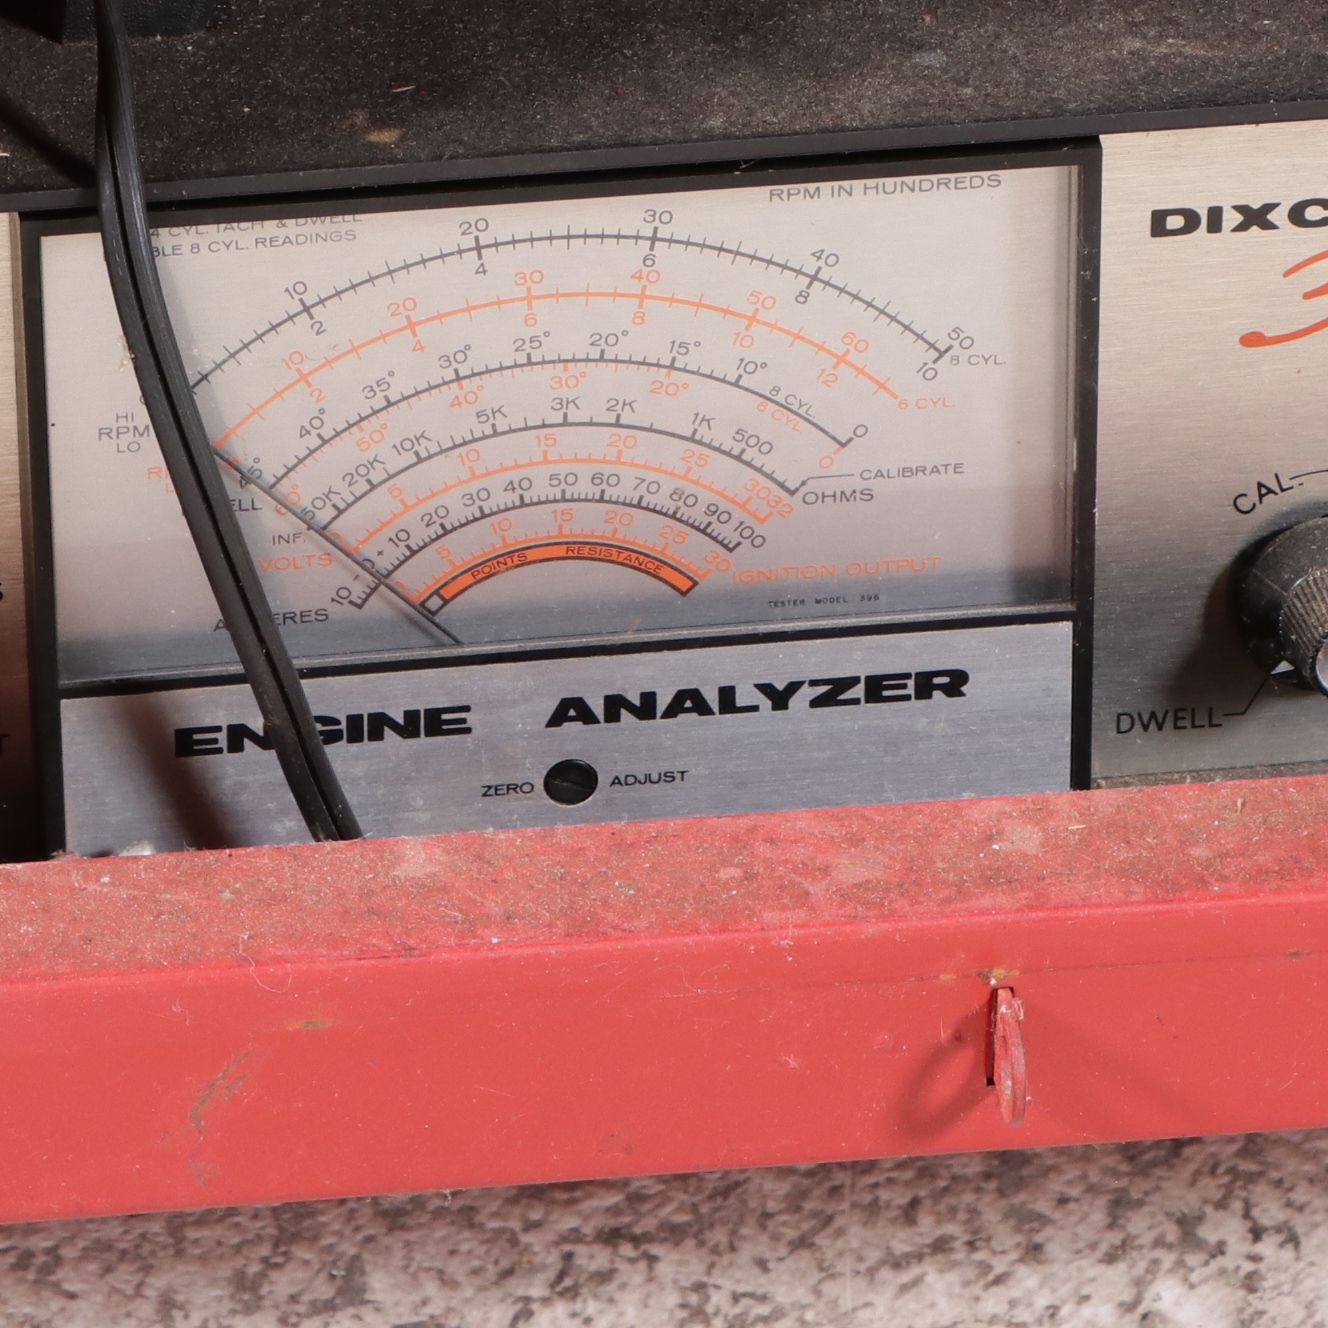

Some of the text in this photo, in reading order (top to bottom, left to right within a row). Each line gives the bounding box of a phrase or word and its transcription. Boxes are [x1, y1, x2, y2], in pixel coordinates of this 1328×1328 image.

[768, 174, 1003, 203] RPM IN HUNDREDS
[190, 243, 201, 255] 8
[208, 240, 248, 254] CYL.
[255, 229, 357, 250] READINGS
[284, 209, 976, 350] 10 20 30 40 50
[281, 351, 306, 371] 10
[386, 297, 417, 317] 20
[514, 269, 545, 286] 30
[630, 269, 661, 284] 40
[746, 289, 777, 310] 50
[840, 331, 870, 354] 60
[310, 254, 938, 382] 2 4 6 8 10
[309, 311, 839, 404] 2 4 6 8 10 12
[950, 353, 1007, 366] 8 CYL.
[298, 407, 326, 440] 40°
[361, 370, 396, 401] 35°
[438, 344, 472, 370] 30°
[512, 330, 551, 353] 25°
[589, 329, 630, 347] 20°
[669, 340, 702, 357] 15°
[735, 357, 768, 376] 10°
[853, 424, 869, 439] 0
[768, 385, 782, 397] 8
[115, 411, 135, 423] HI
[756, 401, 769, 413] 6
[897, 399, 909, 411] 6
[98, 424, 150, 441] RPM
[116, 441, 141, 454] LO
[300, 396, 774, 521] 50K 20K 10K 5K 3K 2K 1K 500
[386, 432, 795, 519] 5 10 15 20 25 30 32
[818, 455, 834, 470] 0
[859, 462, 966, 481] CALIBRATE
[802, 488, 875, 506] OHMS
[330, 586, 353, 607] 10
[388, 528, 411, 550] 10
[420, 504, 450, 529] 20
[461, 487, 491, 508] 30
[503, 476, 533, 494] 40
[548, 471, 579, 488] 50
[590, 471, 621, 488] 60
[633, 476, 661, 495] 70
[669, 487, 699, 509] 80
[703, 502, 733, 525] 90
[733, 520, 767, 550] 100
[434, 507, 734, 573] 5 10 15 20 25 30
[258, 551, 335, 573] VOLTS
[471, 545, 666, 581] POINTS RESISTANCE
[732, 556, 943, 585] IGNITION OUTPUT
[768, 598, 806, 609] TESTER
[814, 595, 849, 605] MODEL
[544, 668, 971, 729] ANALYZER
[1115, 705, 1223, 736] DWELL
[480, 770, 690, 798] ZERO ADJUST
